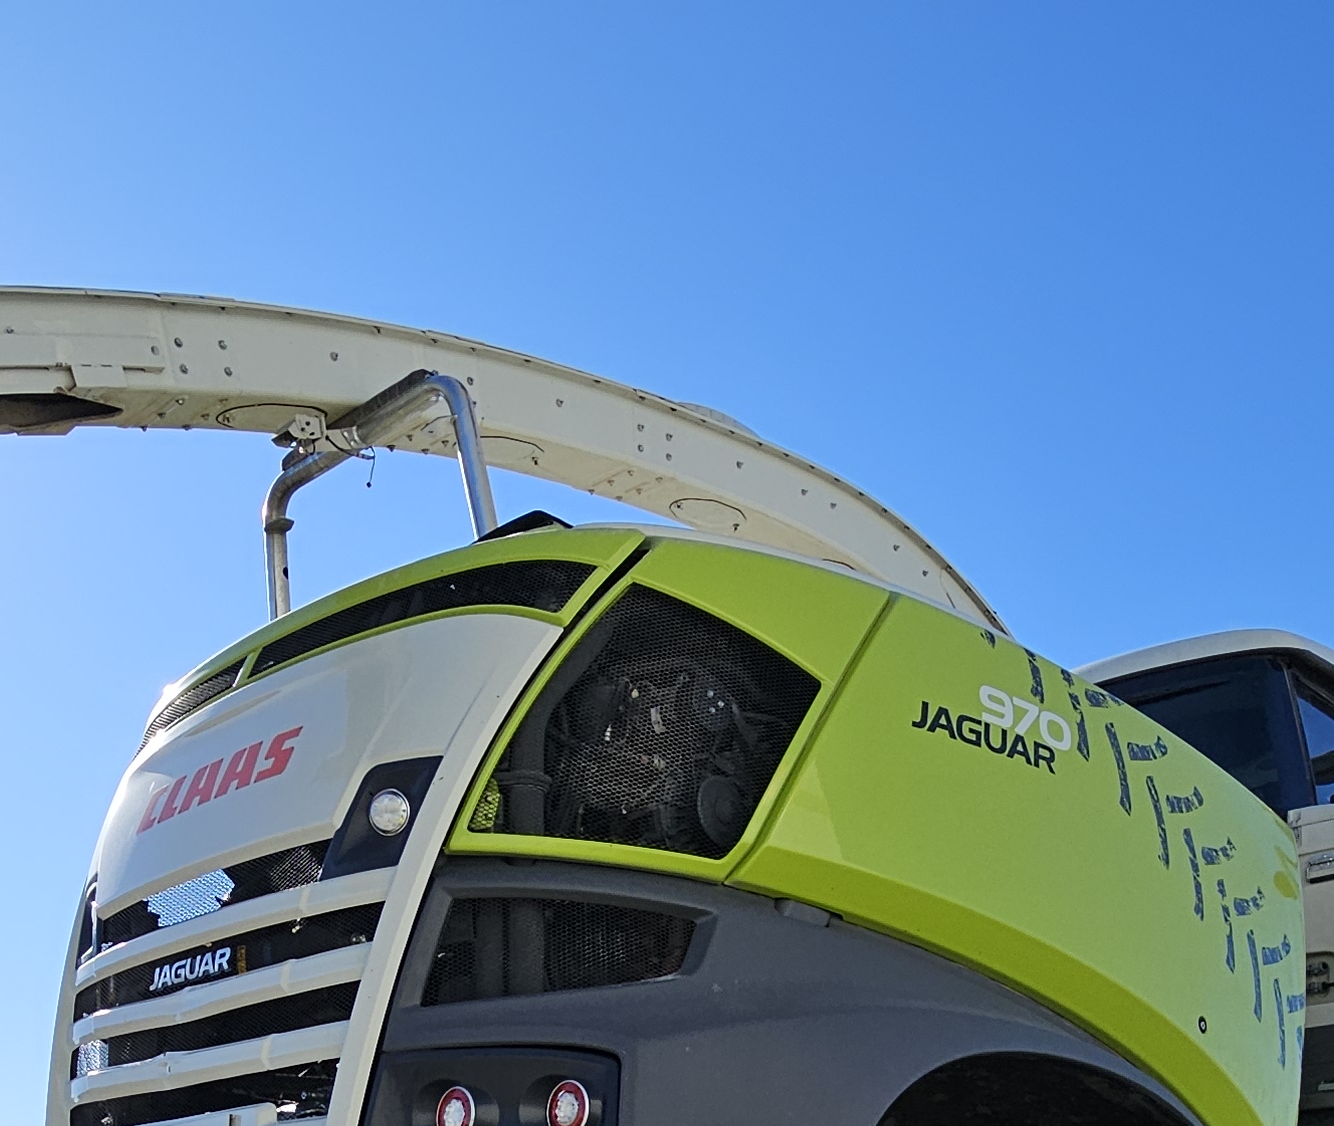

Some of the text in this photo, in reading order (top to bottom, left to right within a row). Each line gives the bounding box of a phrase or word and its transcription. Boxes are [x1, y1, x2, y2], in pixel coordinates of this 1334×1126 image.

[911, 700, 1056, 775] JAGUAR
[979, 685, 1072, 751] 970
[136, 725, 304, 835] CLAAS
[149, 946, 231, 991] JAGUAR
